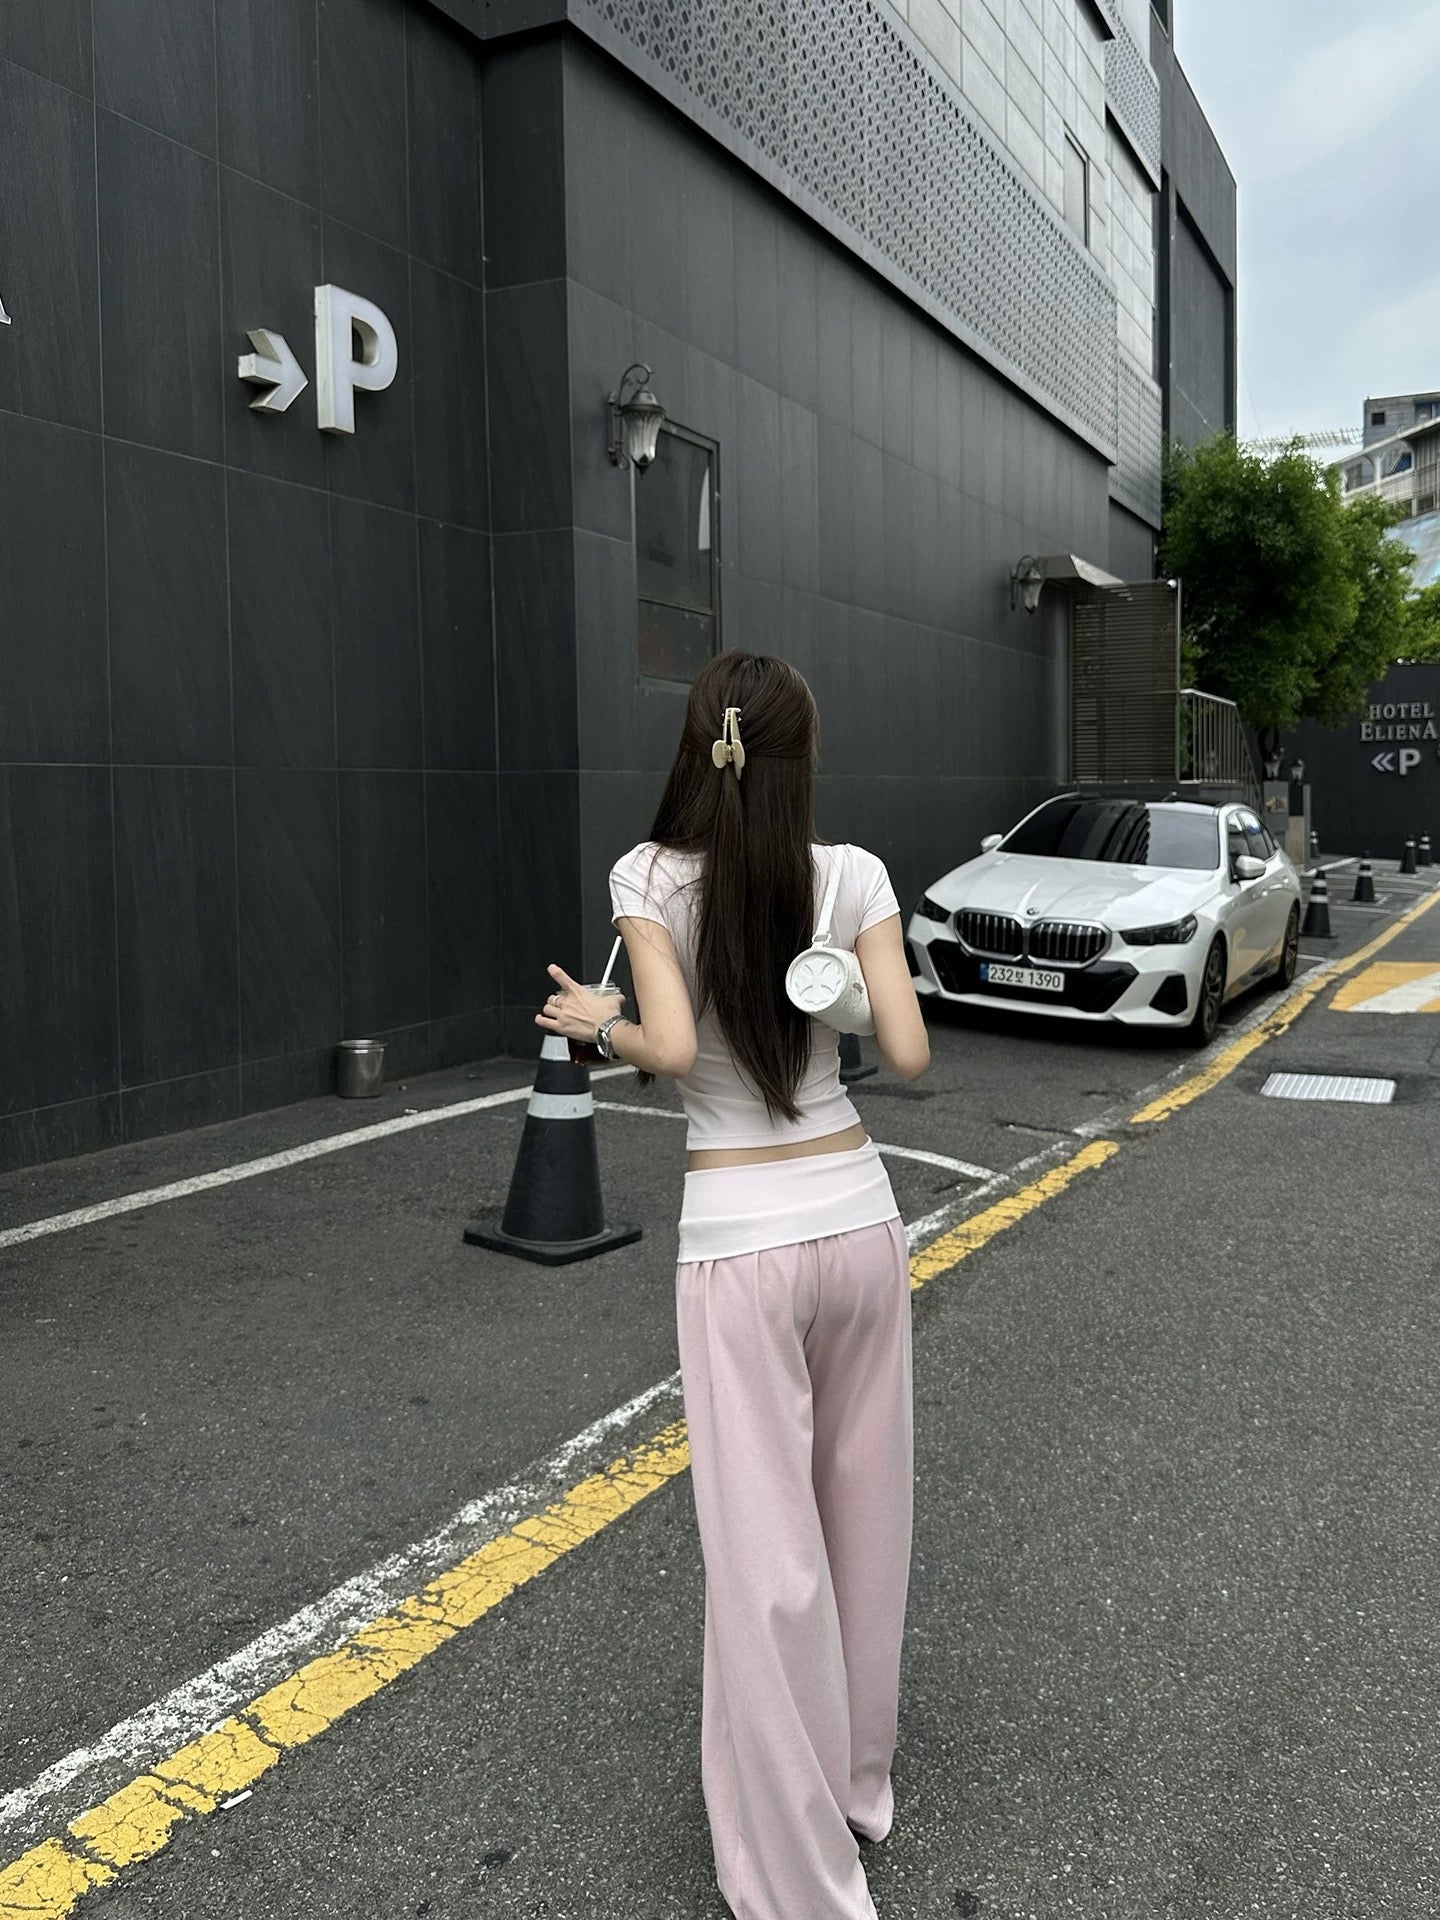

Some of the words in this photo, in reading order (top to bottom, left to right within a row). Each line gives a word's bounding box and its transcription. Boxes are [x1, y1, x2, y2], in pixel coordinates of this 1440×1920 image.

[314, 284, 399, 434] P
[1369, 702, 1434, 720] HOTEL
[1399, 748, 1421, 775] P
[1028, 972, 1061, 988] 1390
